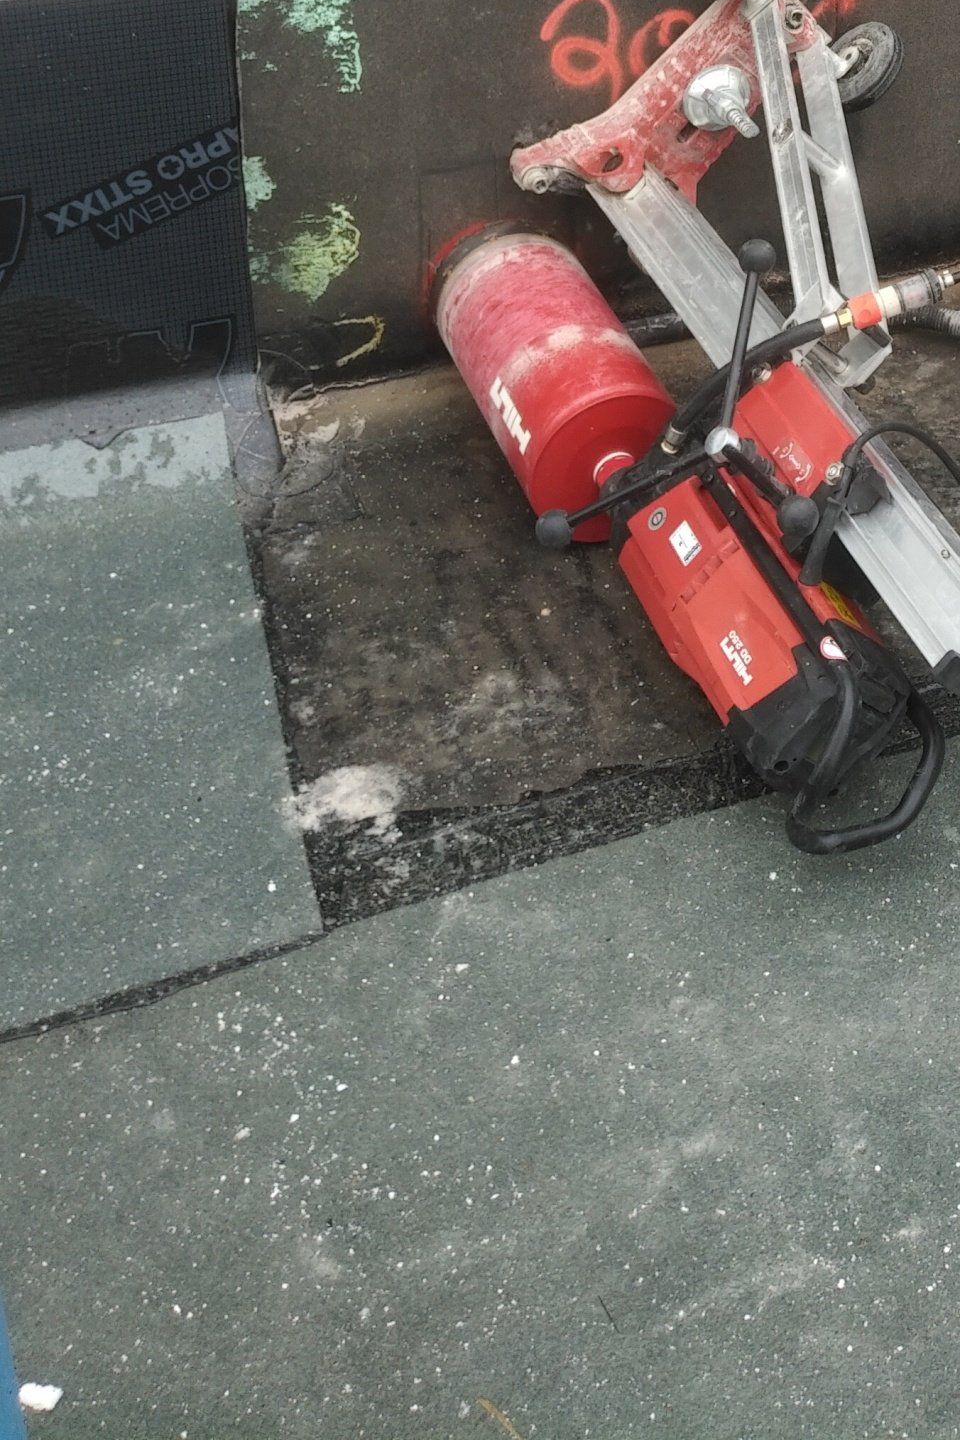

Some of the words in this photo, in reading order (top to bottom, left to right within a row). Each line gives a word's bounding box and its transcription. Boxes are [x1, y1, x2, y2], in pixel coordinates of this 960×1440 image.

[157, 127, 240, 180] APRO
[43, 169, 154, 236] STIXX
[719, 636, 753, 686] HILTI
[728, 629, 744, 650] 250
[740, 648, 753, 665] DD
